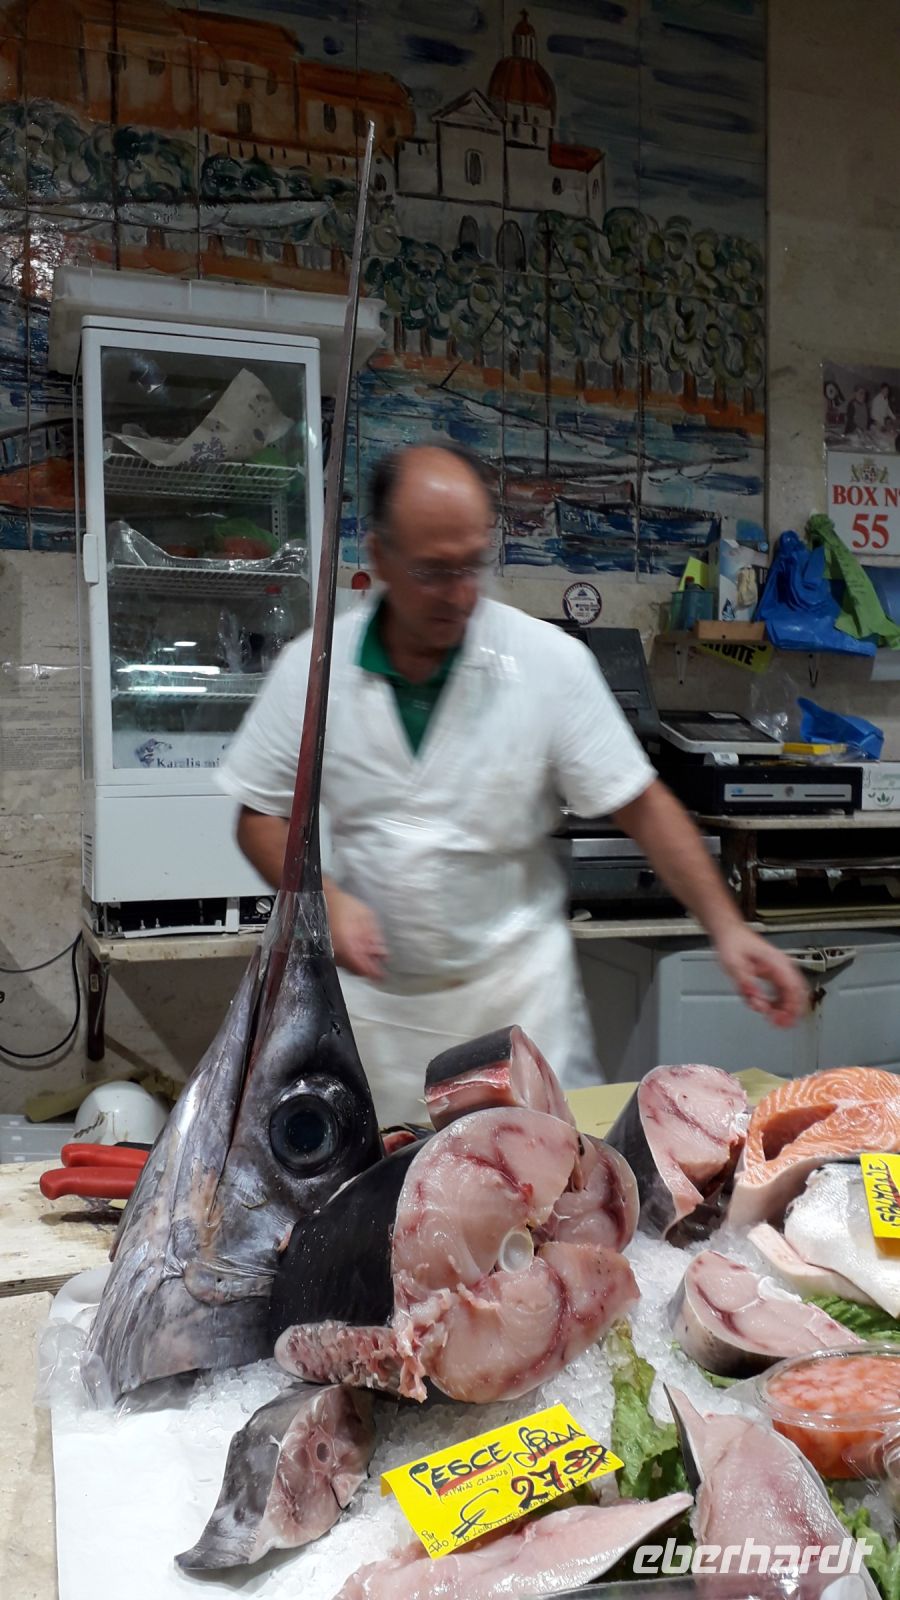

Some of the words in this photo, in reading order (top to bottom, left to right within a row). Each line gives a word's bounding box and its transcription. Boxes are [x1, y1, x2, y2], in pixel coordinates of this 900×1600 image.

[832, 484, 879, 507] BOX
[884, 486, 900, 508] N
[852, 513, 889, 549] 55
[409, 1441, 512, 1496] PESCE
